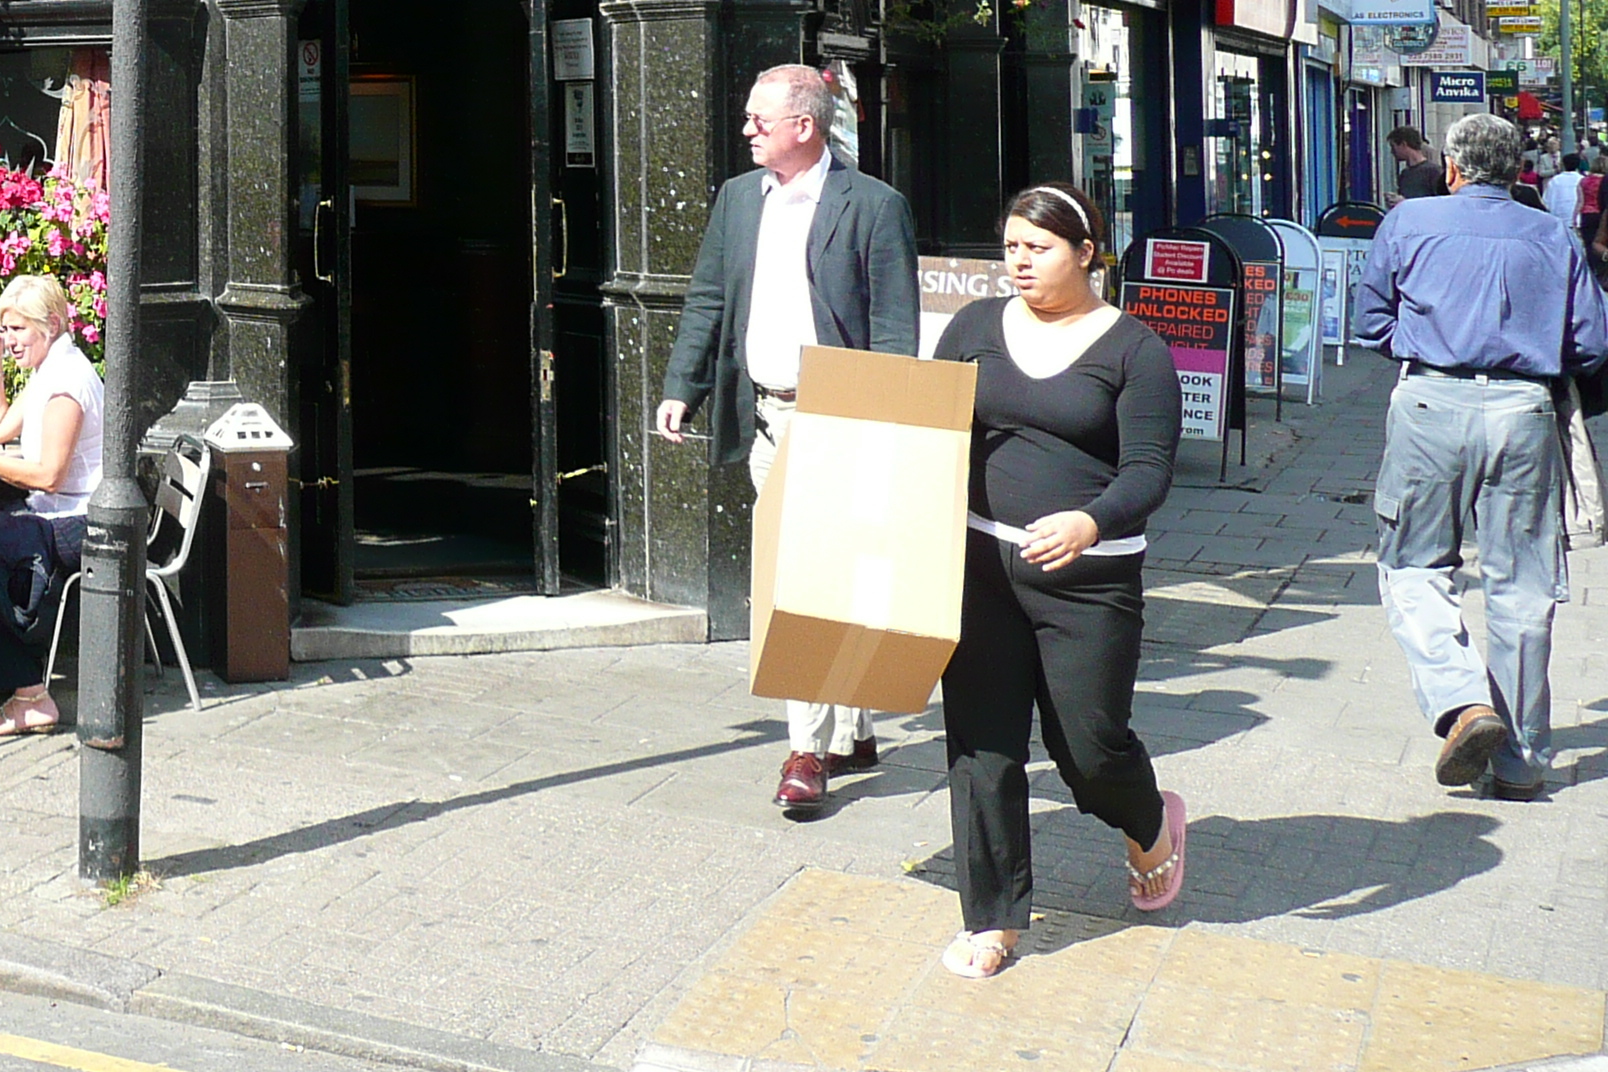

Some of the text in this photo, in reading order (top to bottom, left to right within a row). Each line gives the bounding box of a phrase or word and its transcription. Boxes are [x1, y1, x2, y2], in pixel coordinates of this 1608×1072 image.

[1367, 11, 1425, 19] ELECTRONICS
[1440, 76, 1475, 87] Micro
[1436, 87, 1480, 97] Anvika
[1139, 287, 1217, 305] PHONES
[1126, 302, 1228, 323] UNLOCKED
[1142, 319, 1215, 340] EPAIRED
